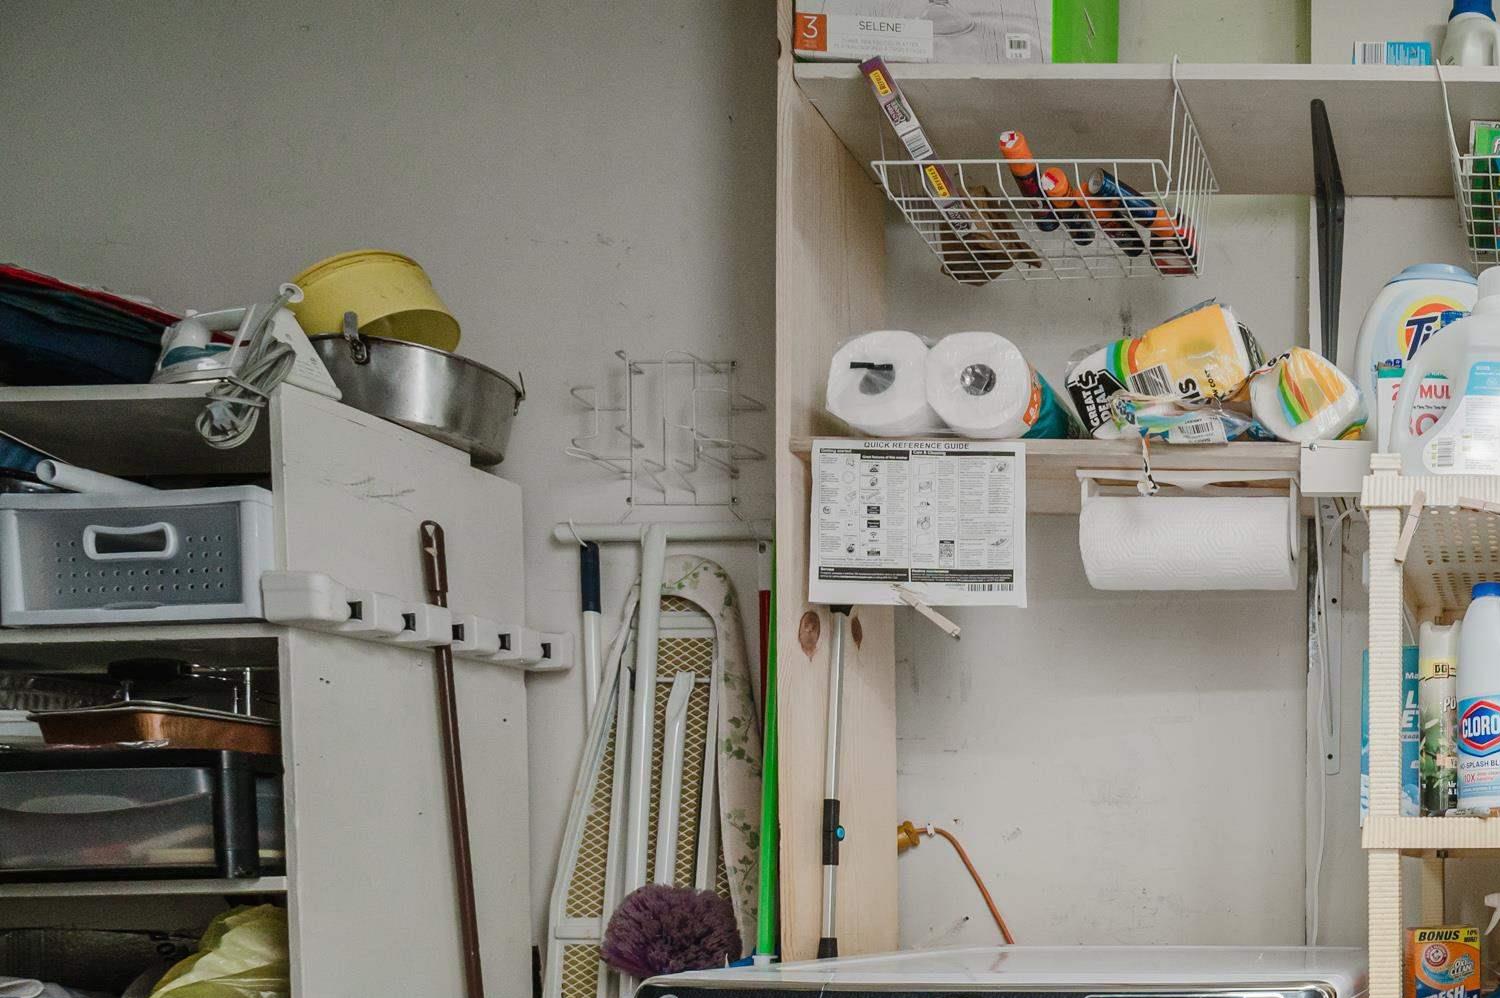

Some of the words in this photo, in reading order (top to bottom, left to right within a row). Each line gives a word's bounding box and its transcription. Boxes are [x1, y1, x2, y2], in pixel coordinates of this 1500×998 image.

[802, 16, 818, 39] 3
[858, 20, 902, 33] SELENE
[1079, 384, 1098, 425] GREAT
[1094, 384, 1112, 424] DEAL
[864, 441, 891, 449] QUICK
[944, 442, 969, 450] GUIDE
[1418, 930, 1460, 941] BONUS
